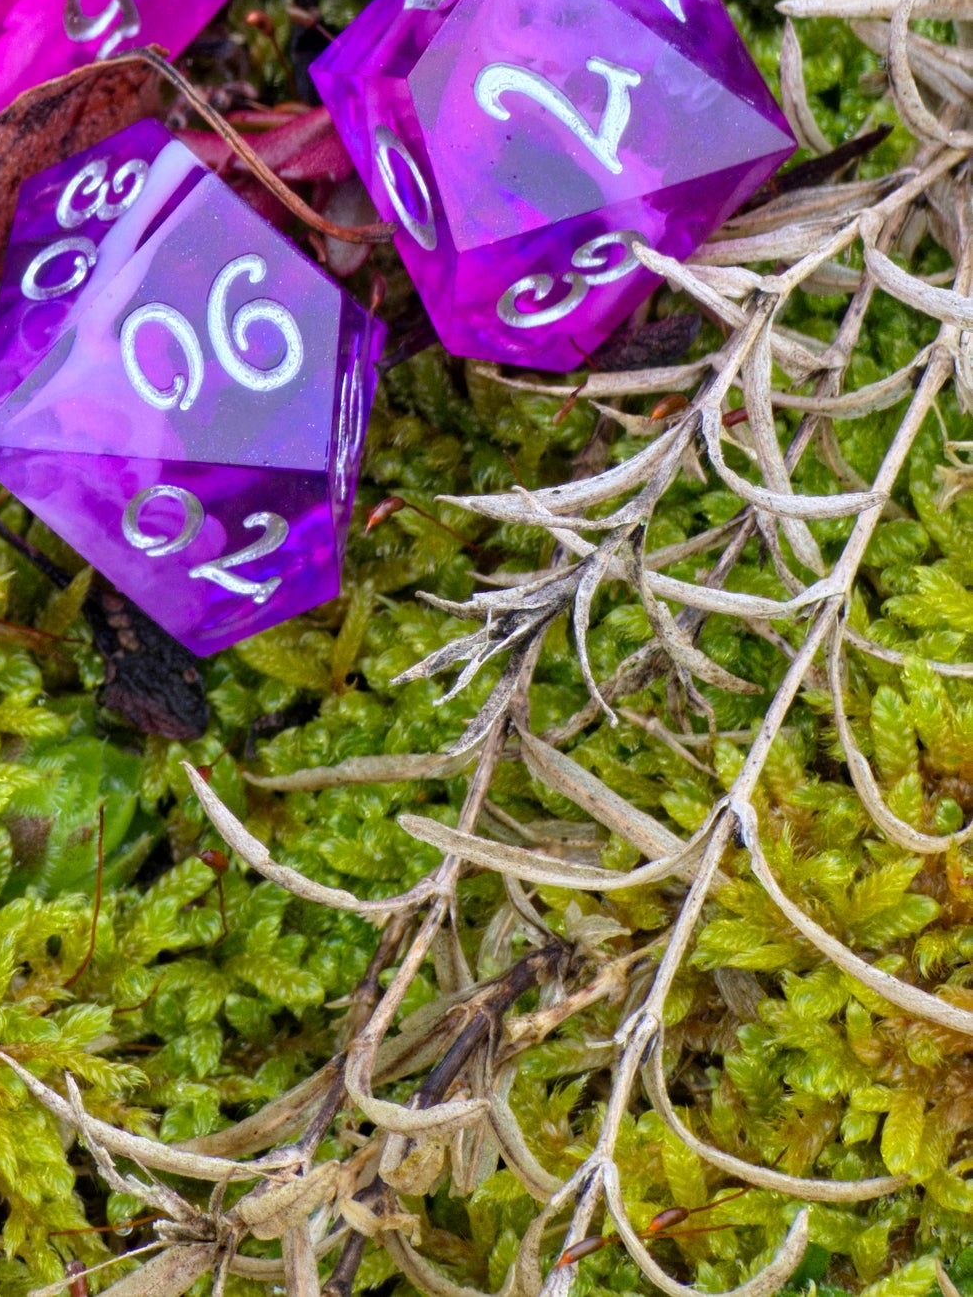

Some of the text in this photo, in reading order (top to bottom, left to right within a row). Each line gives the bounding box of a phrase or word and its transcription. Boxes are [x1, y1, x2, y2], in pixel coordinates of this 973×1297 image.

[474, 56, 640, 174] 2
[20, 158, 149, 301] 30
[374, 124, 437, 251] 0
[496, 229, 650, 329] 3
